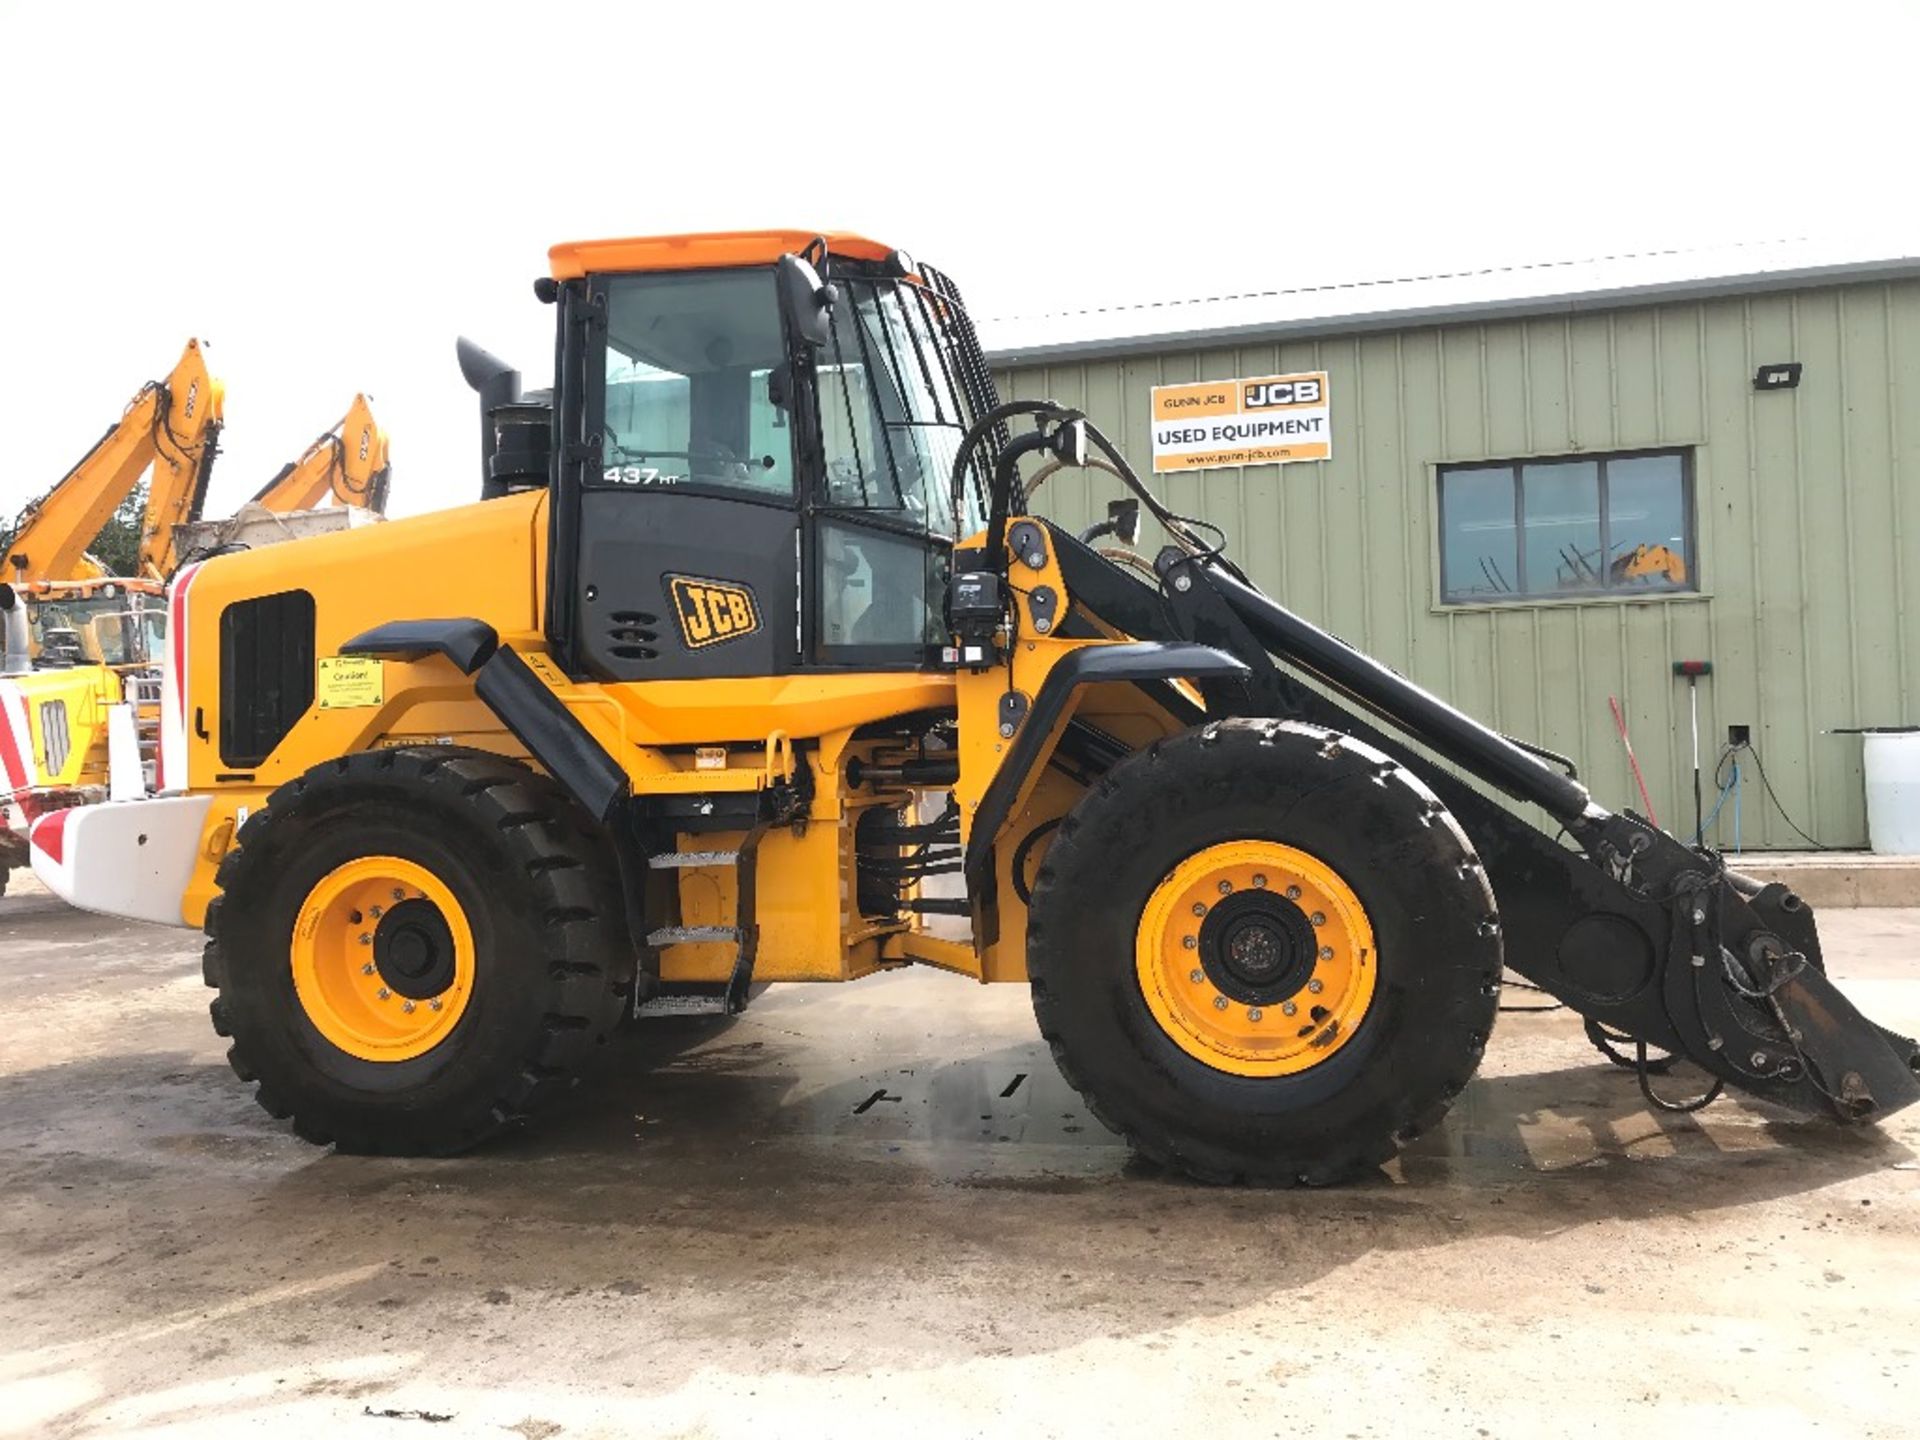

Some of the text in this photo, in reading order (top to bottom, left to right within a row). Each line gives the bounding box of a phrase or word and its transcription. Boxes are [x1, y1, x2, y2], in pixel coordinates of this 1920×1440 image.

[1164, 394, 1226, 409] GUNN JCB
[1246, 381, 1320, 406] JCB
[1158, 418, 1323, 445] USED EQUIPMENT
[1186, 449, 1291, 464] www.gunn-jcb.com
[603, 466, 659, 485] 437
[687, 586, 749, 640] JCB
